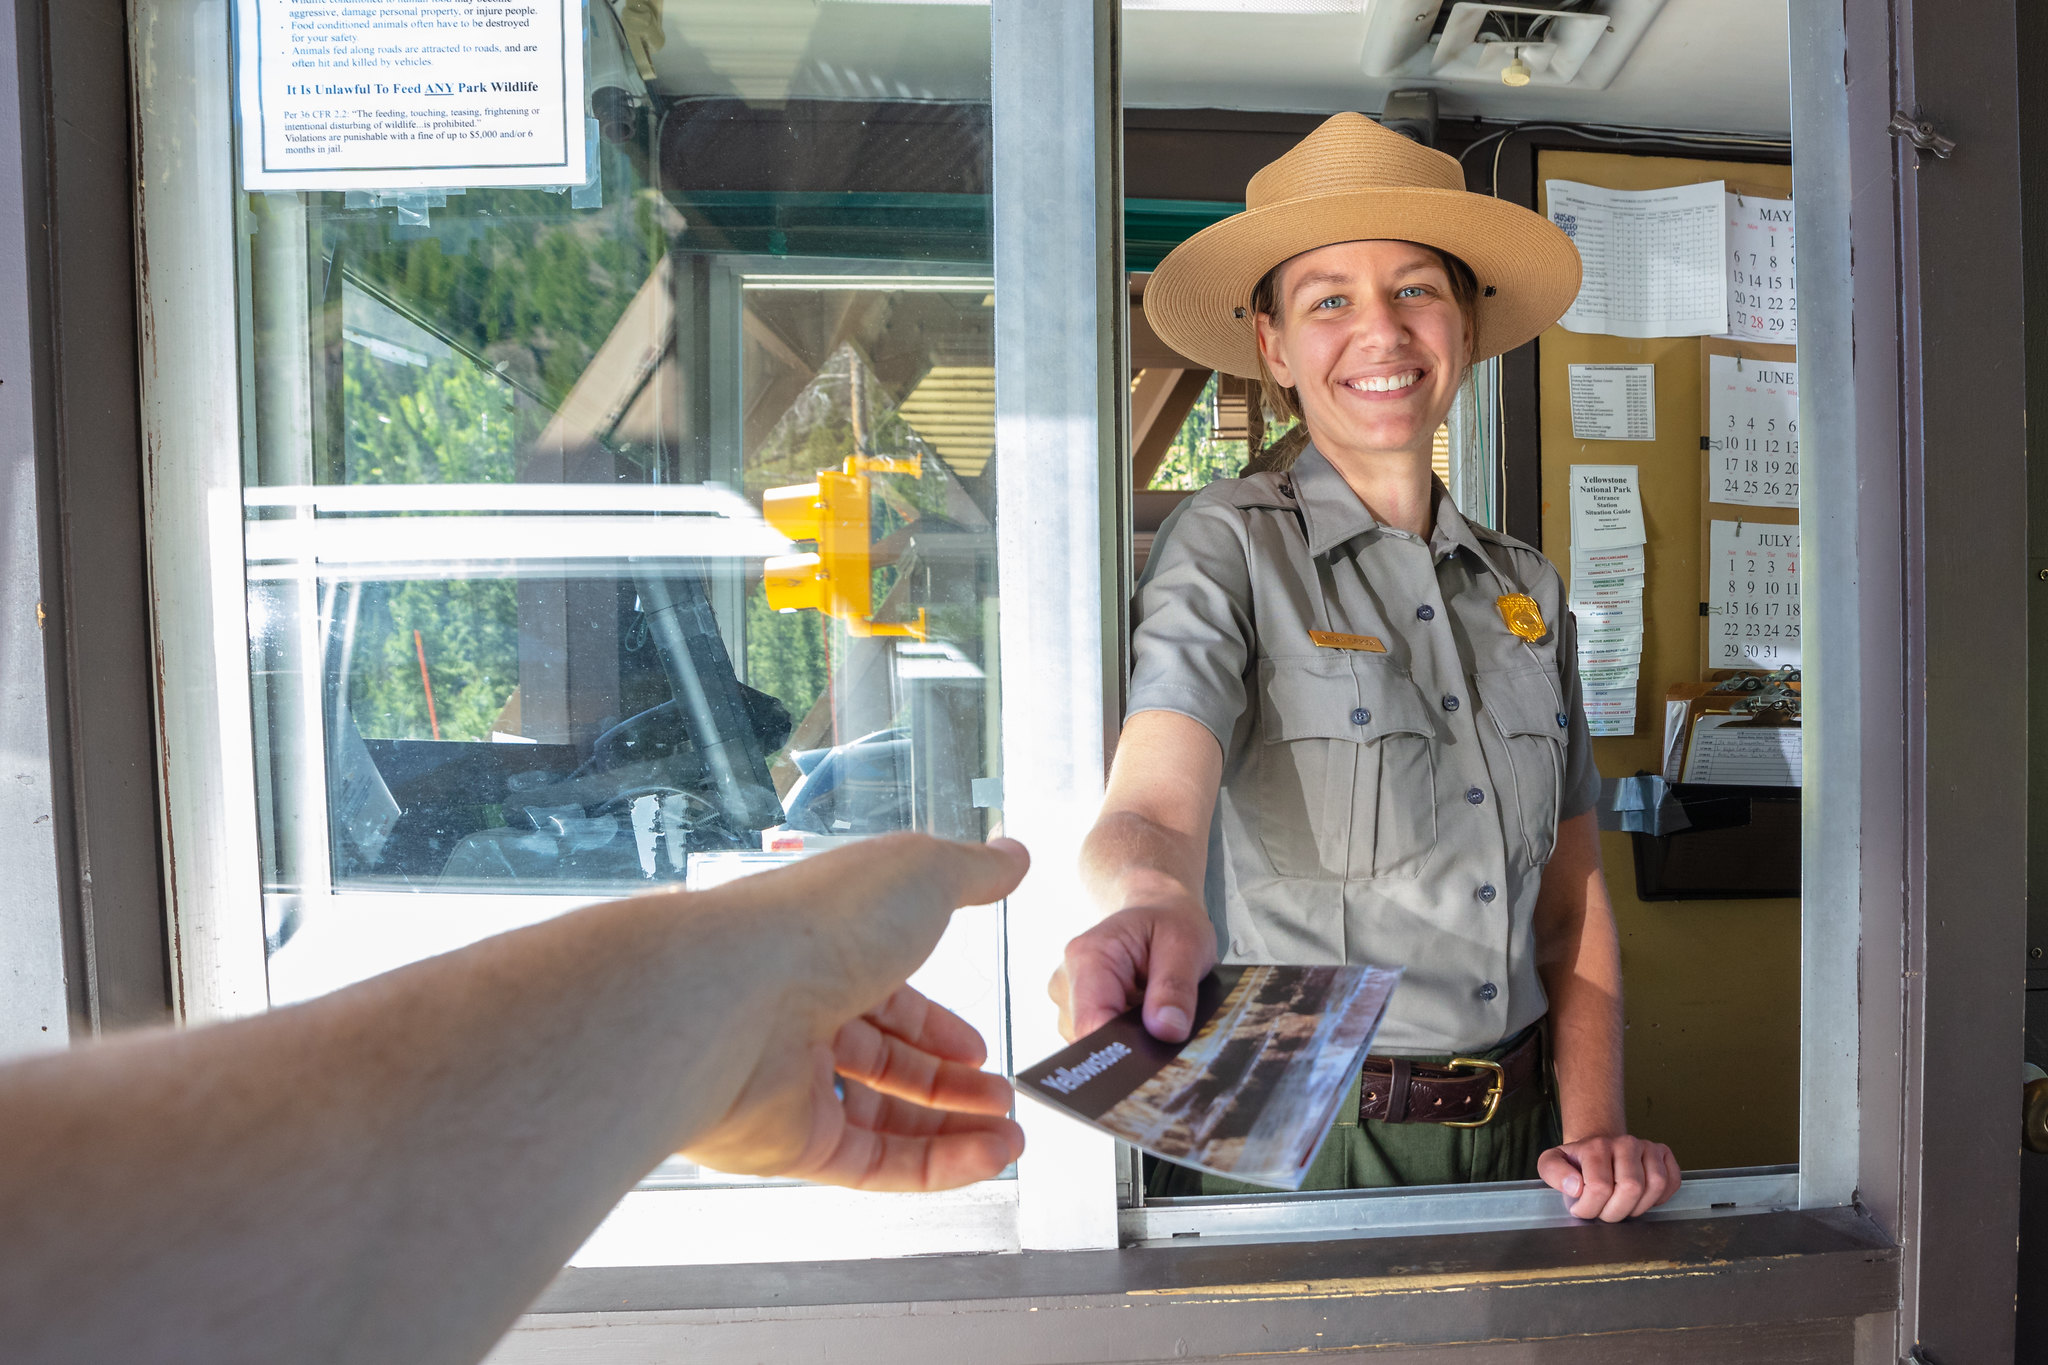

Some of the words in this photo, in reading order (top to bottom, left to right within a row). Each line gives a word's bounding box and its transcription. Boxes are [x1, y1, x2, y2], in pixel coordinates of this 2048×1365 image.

[289, 6, 338, 18] aggressive,
[341, 6, 376, 18] damage
[379, 5, 417, 17] personal
[476, 4, 502, 16] injure
[504, 4, 537, 16] people.
[291, 20, 314, 29] Food
[316, 19, 369, 29] conditioned
[372, 18, 408, 28] animals
[410, 18, 433, 28] often
[436, 18, 457, 27] have
[460, 17, 469, 27] to
[472, 17, 483, 27] be
[485, 17, 529, 29] destroyed
[291, 33, 304, 42] for
[307, 35, 328, 45] your
[292, 45, 330, 55] Animals
[333, 45, 347, 54] fed
[350, 44, 374, 56] along
[378, 44, 402, 54] roads
[421, 43, 460, 53] attracted
[463, 43, 471, 53] to
[474, 43, 501, 53] roads,
[504, 42, 520, 52] and
[292, 58, 315, 68] often
[318, 58, 330, 68] hit
[333, 57, 349, 67] and
[352, 57, 377, 67] killed
[380, 57, 390, 69] by
[286, 84, 296, 96] It
[300, 84, 311, 95] Is
[315, 83, 370, 95] Unlawful
[373, 83, 389, 94] To
[393, 82, 421, 94] Feed
[424, 82, 454, 95] ANY
[458, 81, 487, 93] Park
[490, 81, 538, 92] Wildlife
[284, 109, 297, 119] Per
[300, 109, 310, 119] 36
[312, 109, 331, 119] CFR
[375, 108, 408, 120] feeding,
[410, 107, 448, 119] touching,
[450, 106, 481, 119] teasing,
[484, 106, 529, 118] frightening
[284, 120, 327, 130] intentional
[329, 120, 371, 132] disturbing
[373, 120, 382, 129] of
[285, 132, 326, 142] Violations
[343, 131, 387, 143] punishable
[390, 130, 408, 140] with
[418, 130, 433, 140] fine
[436, 130, 445, 139] of
[446, 132, 457, 141] up
[459, 129, 467, 139] to
[470, 129, 497, 140] $5,000
[528, 128, 532, 138] 6
[285, 144, 315, 154] months
[318, 144, 325, 153] in
[328, 143, 342, 155] jail.
[1760, 209, 1791, 221] MAY
[1734, 251, 1740, 262] 6
[1750, 254, 1756, 266] 7
[1770, 256, 1777, 268] 8
[1734, 270, 1743, 283] 13
[1750, 274, 1761, 287] 14
[1769, 277, 1782, 289] 15
[1735, 290, 1745, 304] 20
[1749, 295, 1760, 308] 21
[1768, 298, 1783, 310] 22
[1738, 312, 1746, 325] 27
[1751, 315, 1763, 329] 28
[1769, 318, 1784, 330] 29
[1757, 371, 1793, 384] JUNE
[1729, 415, 1735, 427] 3
[1747, 417, 1754, 429] 4
[1768, 419, 1774, 431] 5
[1789, 421, 1796, 432] 6
[1727, 437, 1738, 449] 10
[1746, 439, 1756, 451] 11
[1766, 440, 1779, 452] 12
[1726, 458, 1738, 470] 17
[1746, 460, 1758, 472] 18
[1766, 461, 1779, 473] 19
[1785, 462, 1798, 474] 20
[1583, 476, 1627, 484] Yellowstone
[1725, 479, 1738, 492] 24
[1744, 481, 1757, 493] 25
[1764, 482, 1779, 495] 26
[1785, 483, 1798, 496] 27
[1758, 534, 1792, 547] JULY
[1748, 560, 1755, 572] 2
[1768, 561, 1774, 573] 3
[1788, 562, 1795, 573] 4
[1729, 580, 1735, 593] 8
[1748, 581, 1754, 593] 9
[1766, 582, 1779, 594] 10
[1787, 583, 1797, 595] 11
[1726, 602, 1738, 614] 15
[1746, 603, 1758, 615] 16
[1766, 604, 1778, 615] 17
[1787, 604, 1799, 616] 18
[1725, 623, 1738, 635] 22
[1746, 624, 1760, 636] 23
[1764, 624, 1779, 636] 24
[1785, 625, 1799, 637] 25
[1725, 644, 1738, 657] 29
[1745, 645, 1758, 657] 30
[1764, 646, 1777, 658] 31
[1040, 1042, 1131, 1094] Yellowstone
